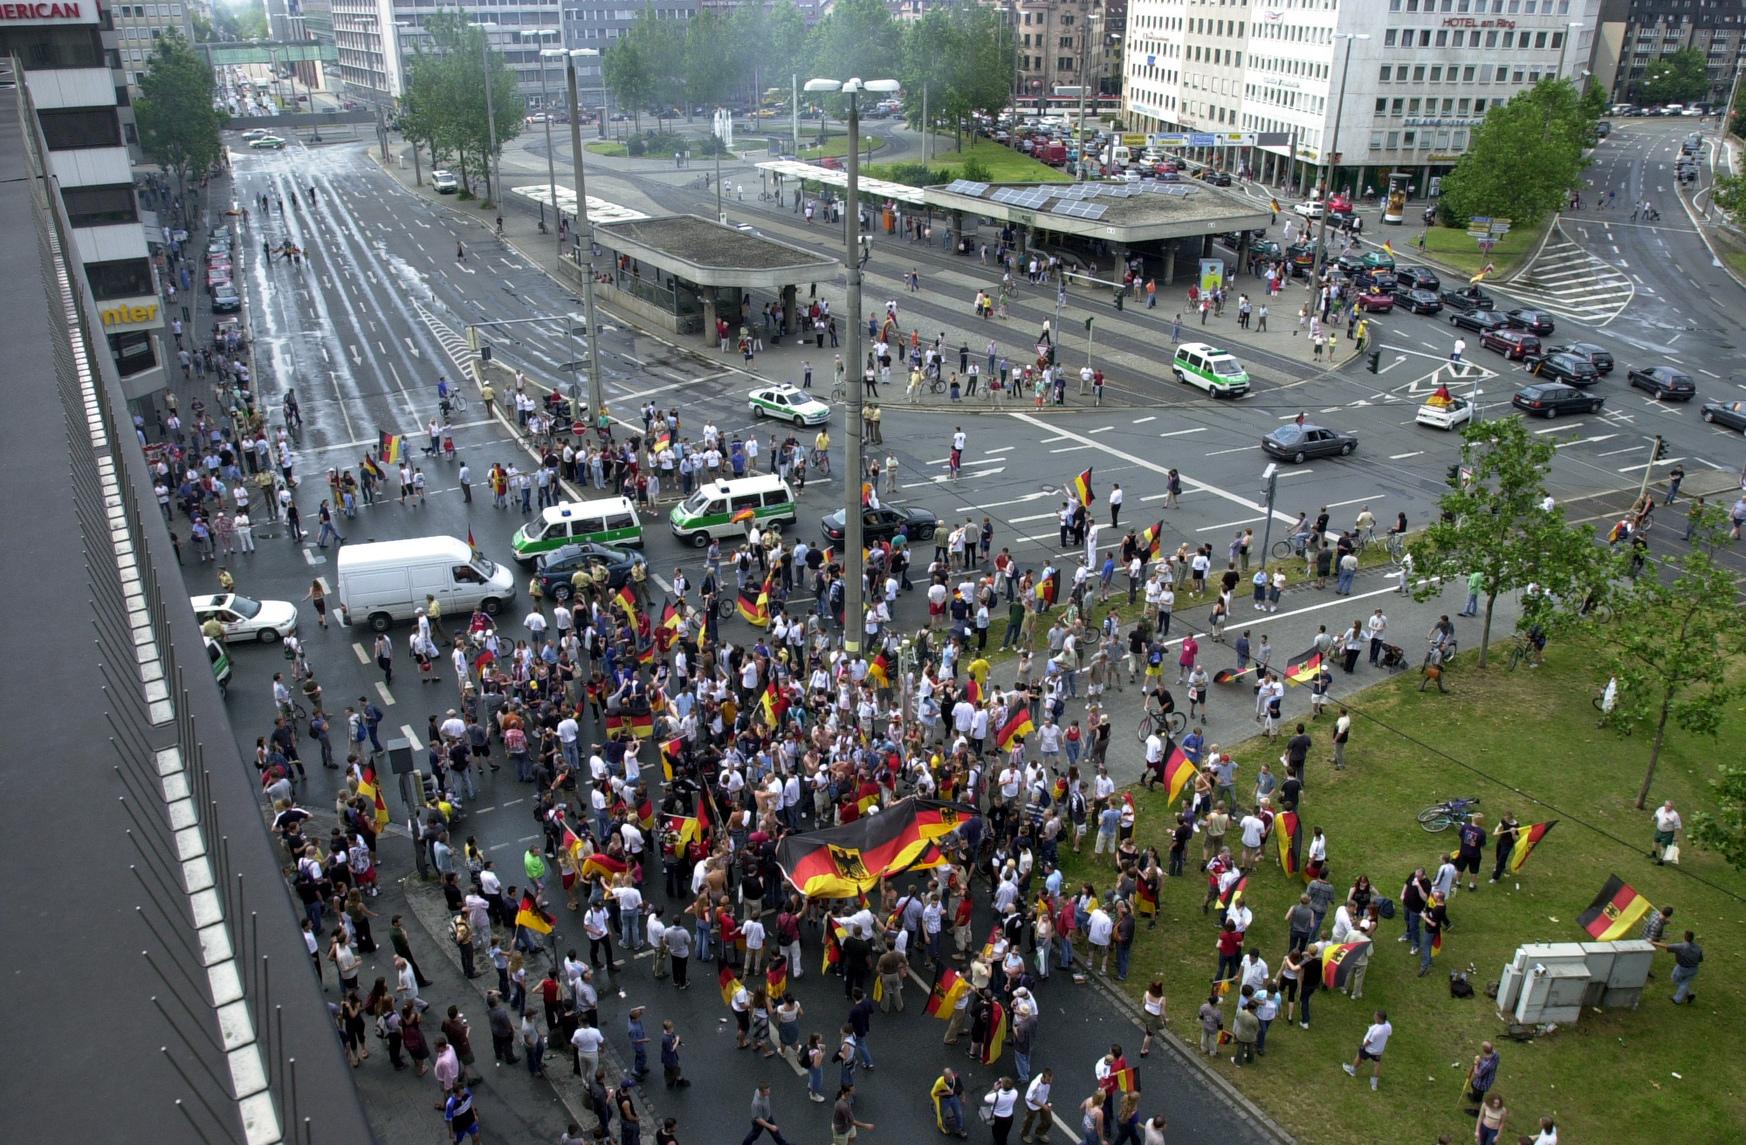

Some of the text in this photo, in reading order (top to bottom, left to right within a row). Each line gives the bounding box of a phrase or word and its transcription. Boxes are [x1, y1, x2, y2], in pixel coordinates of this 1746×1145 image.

[1442, 17, 1516, 29] HOTEL am Ring
[102, 303, 157, 326] nter
